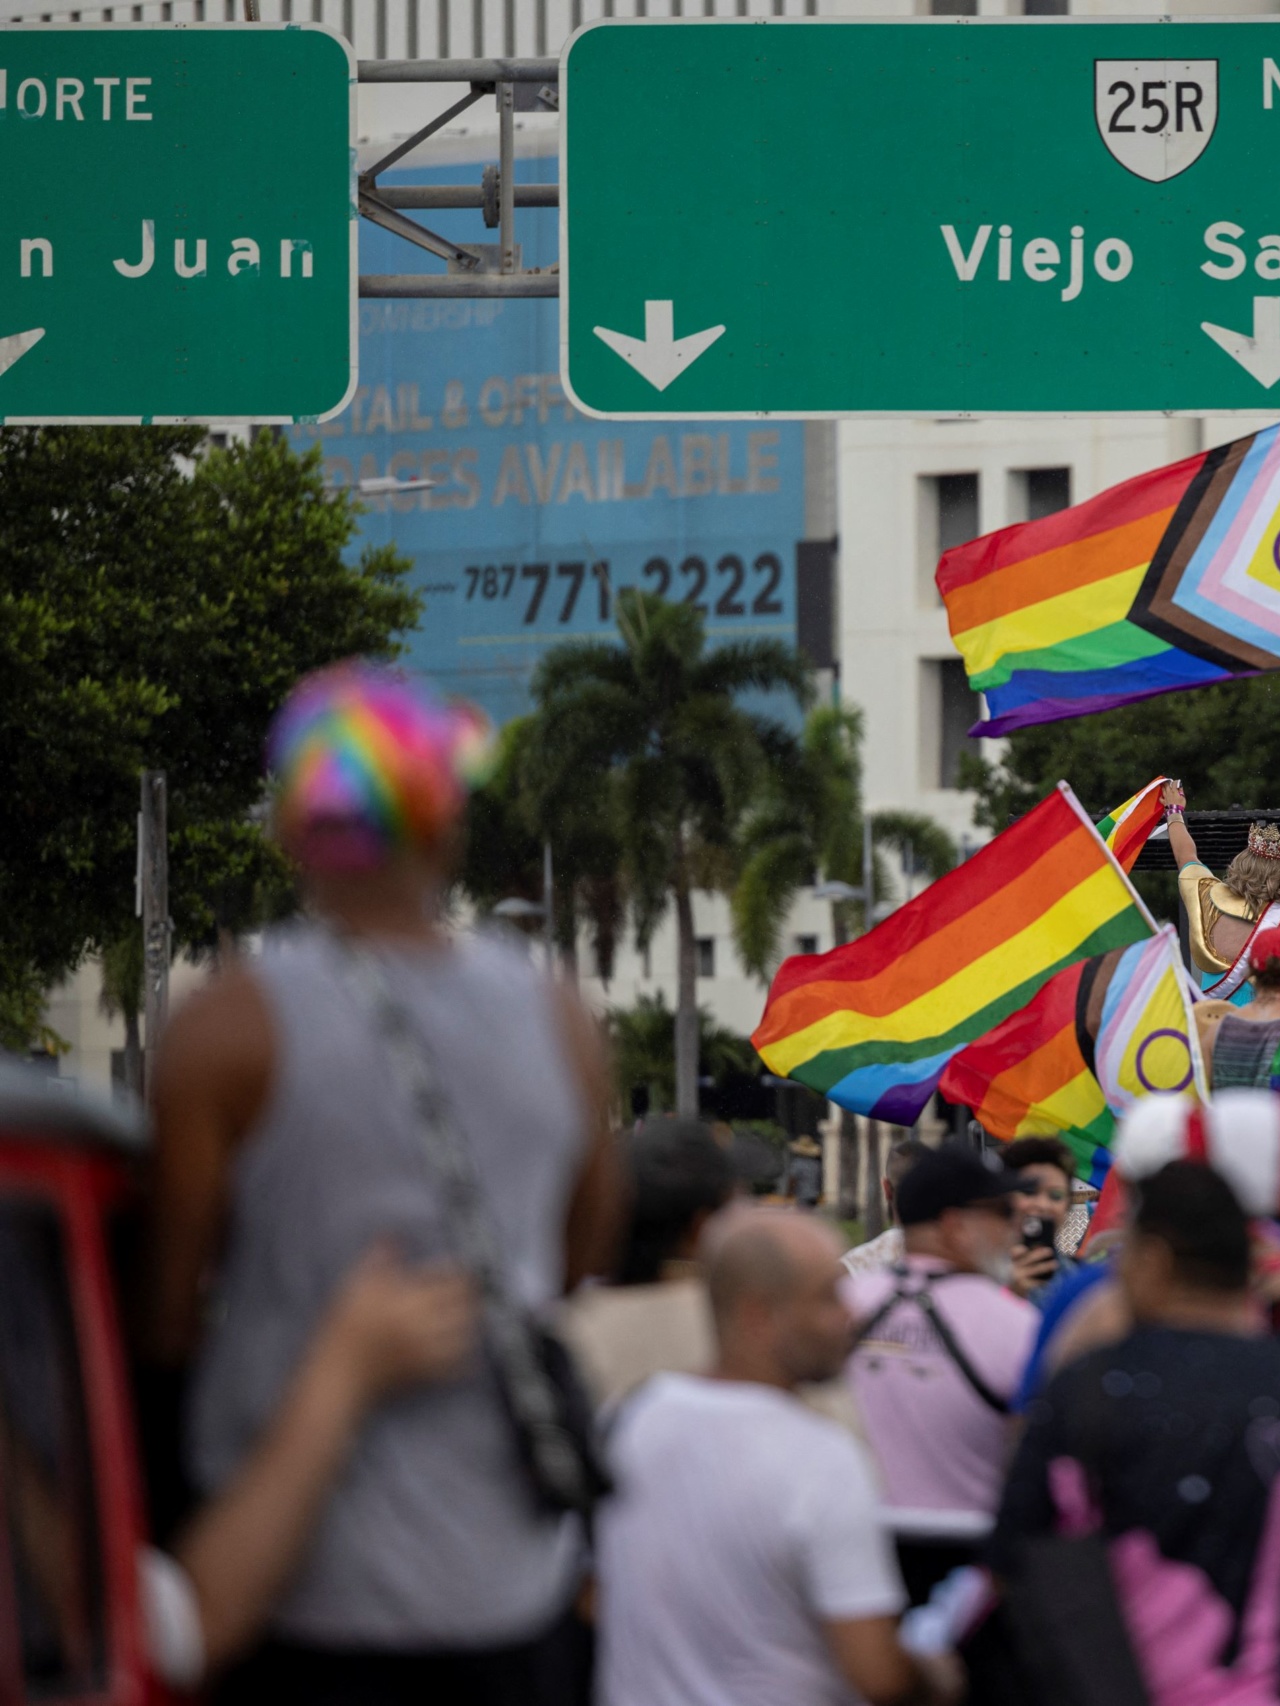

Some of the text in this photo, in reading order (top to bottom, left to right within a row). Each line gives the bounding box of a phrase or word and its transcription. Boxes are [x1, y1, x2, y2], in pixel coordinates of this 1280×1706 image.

[0, 69, 154, 122] ORTE
[1107, 80, 1205, 134] 25R
[113, 219, 314, 279] Juan
[940, 224, 1134, 303] Viejo
[293, 373, 594, 439] TAIL & OFF
[322, 429, 782, 514] PACES AVAILABLE
[463, 564, 517, 601] 787
